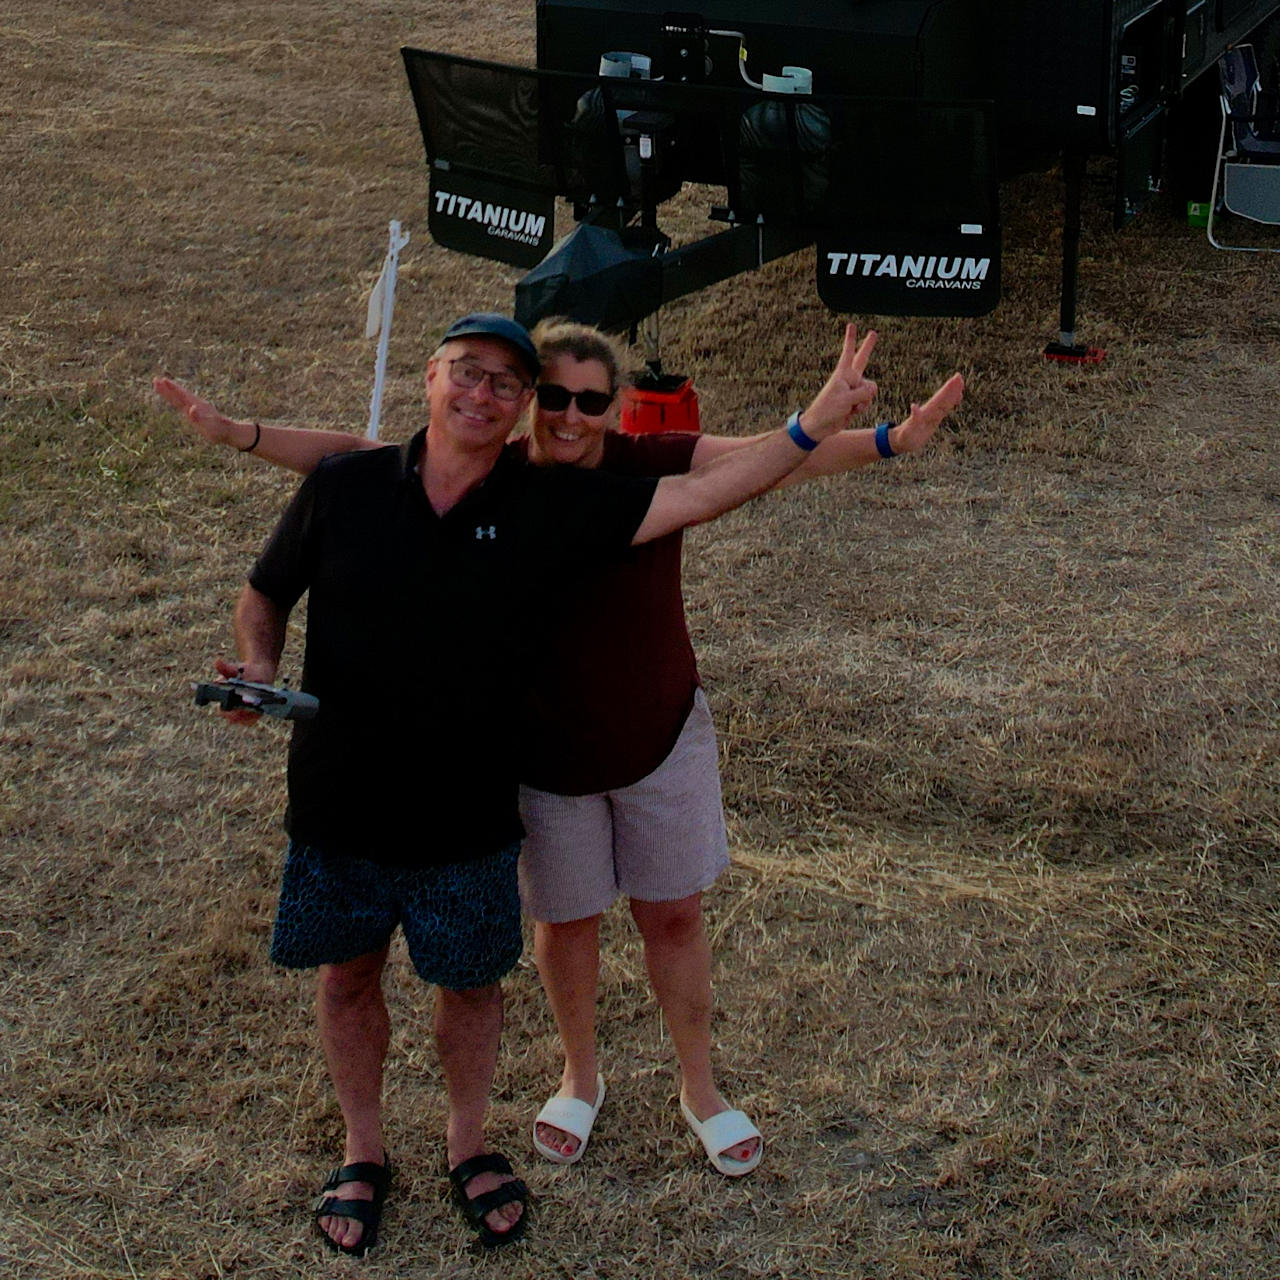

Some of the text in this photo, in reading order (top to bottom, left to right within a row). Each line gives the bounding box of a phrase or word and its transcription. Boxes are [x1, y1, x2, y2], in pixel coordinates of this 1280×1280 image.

[435, 190, 546, 238] TITANIUM
[487, 225, 540, 247] CARAVANS
[827, 252, 991, 280] TITANIUM
[906, 278, 981, 290] CARAVANS
